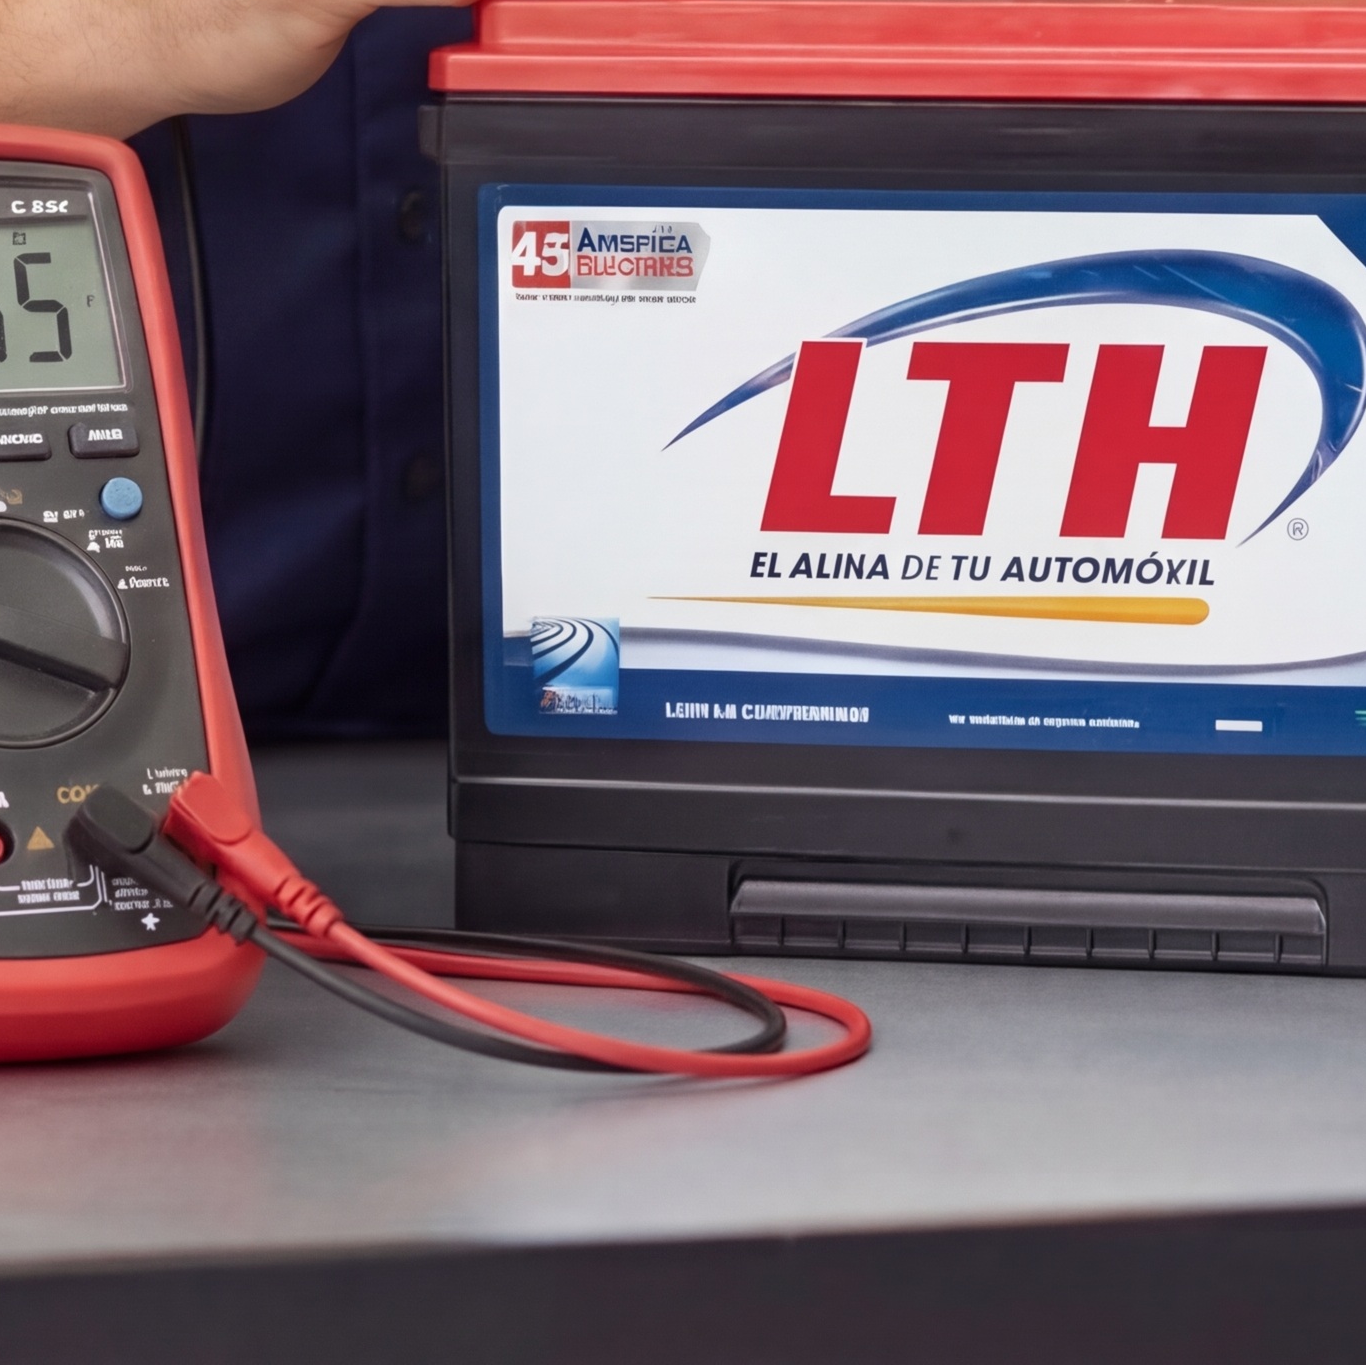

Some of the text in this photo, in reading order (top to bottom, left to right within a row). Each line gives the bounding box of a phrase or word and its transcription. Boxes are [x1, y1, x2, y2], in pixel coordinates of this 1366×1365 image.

[760, 341, 1268, 540] LTH
[750, 552, 784, 579] EL
[788, 552, 890, 581] ALINA
[901, 554, 941, 581] DE
[951, 555, 991, 582] TU
